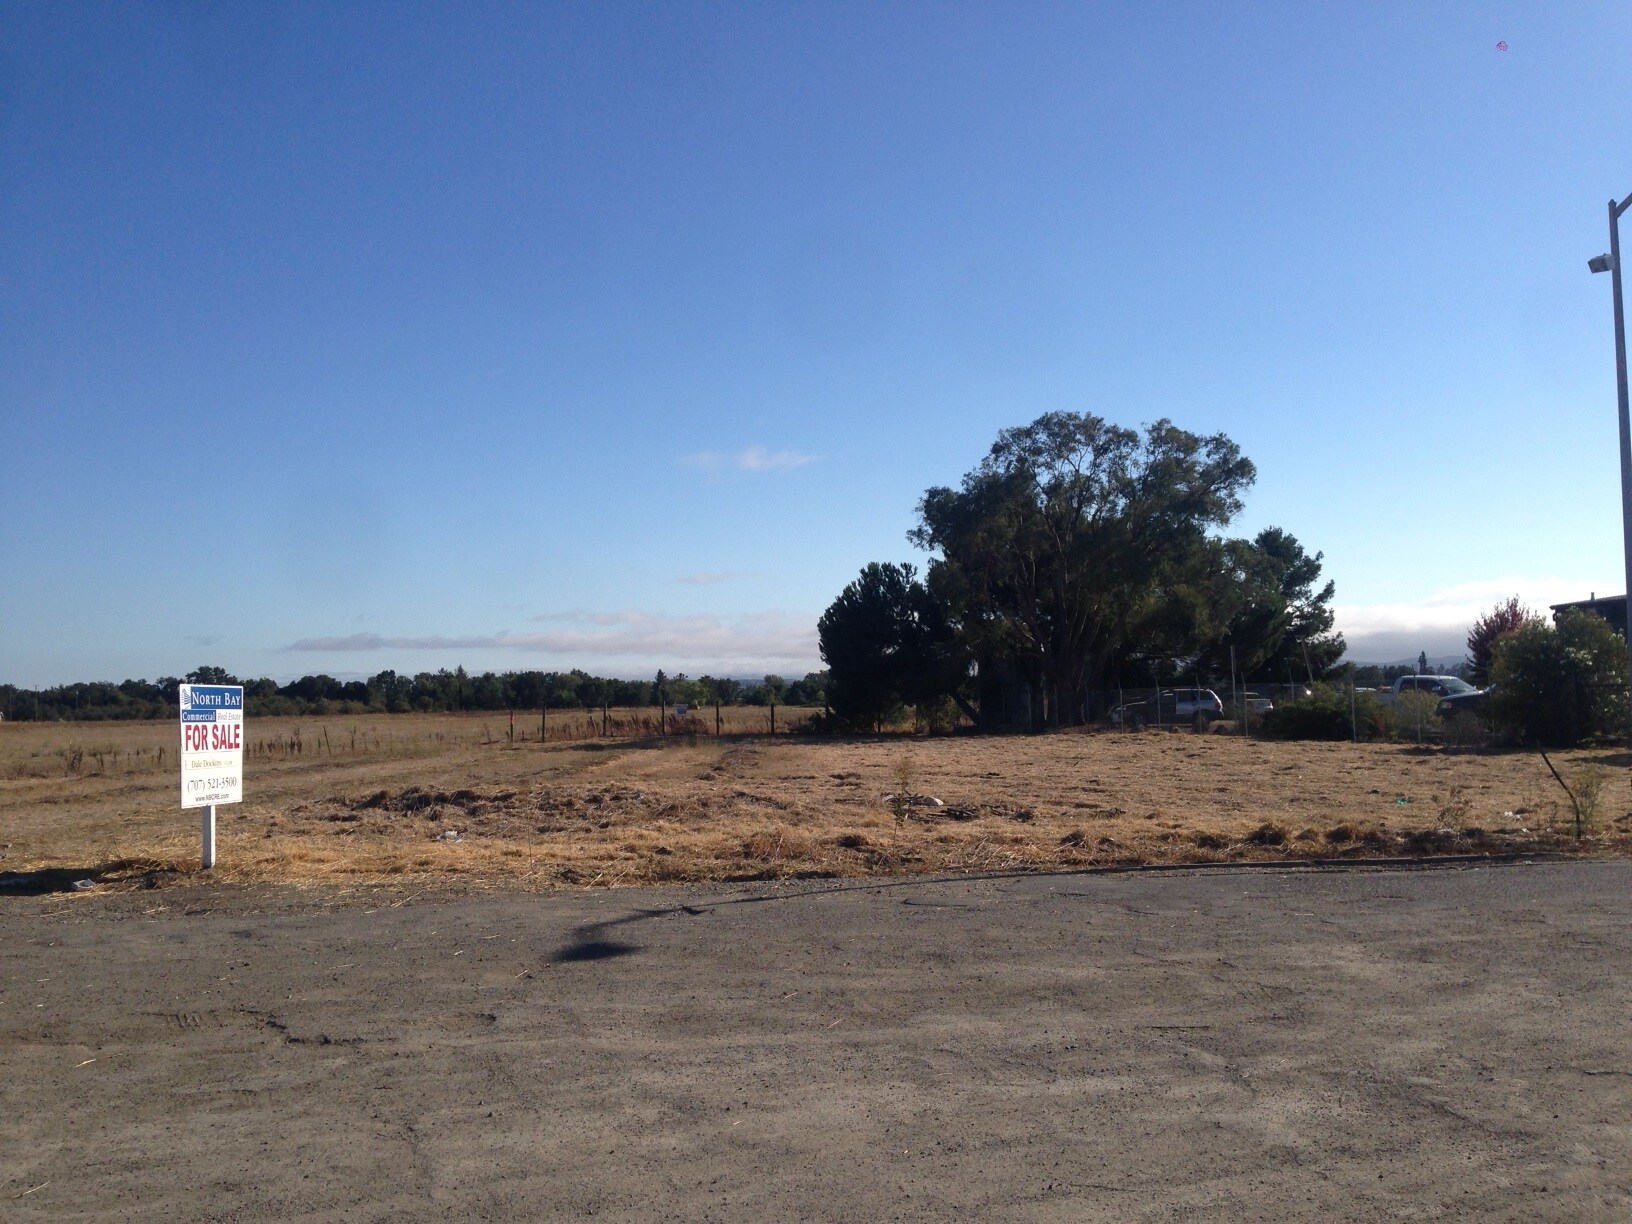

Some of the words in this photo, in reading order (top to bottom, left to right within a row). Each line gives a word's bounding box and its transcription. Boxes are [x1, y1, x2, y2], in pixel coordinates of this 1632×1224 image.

[191, 692, 221, 706] NORTH
[224, 692, 241, 706] BAY
[182, 711, 216, 721] Commercial
[185, 724, 209, 751] FOR
[212, 724, 240, 750] SALE
[187, 779, 206, 794] (707)
[207, 776, 237, 790] 521-3500
